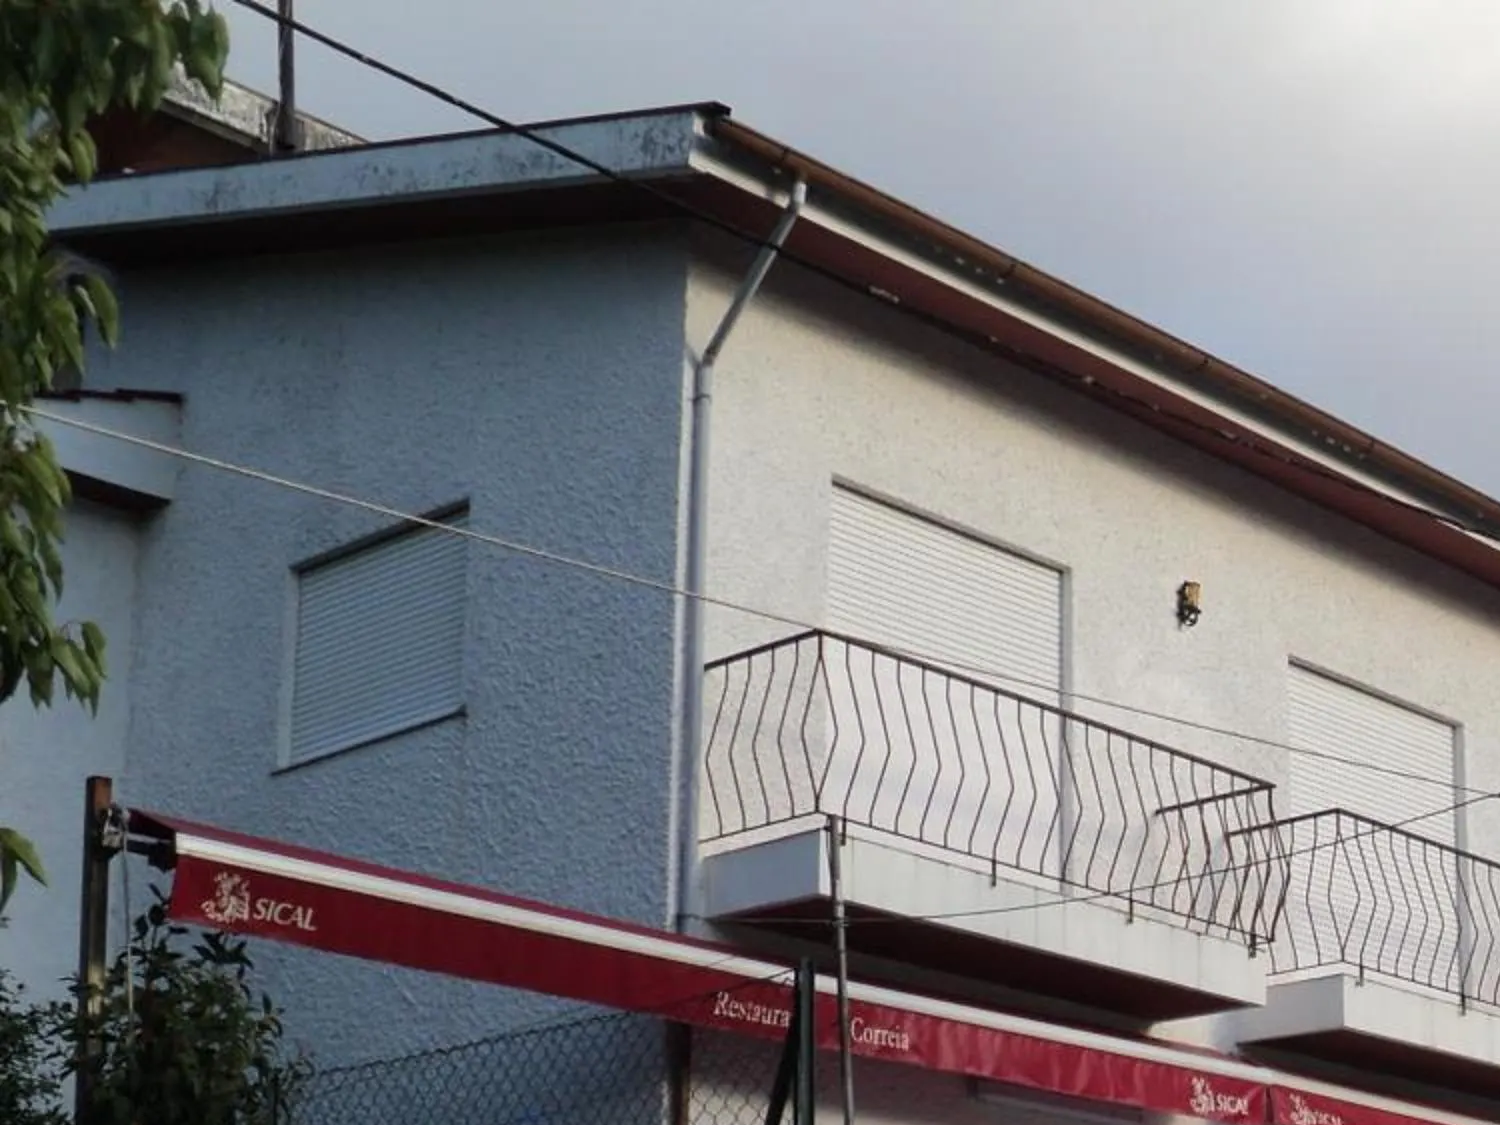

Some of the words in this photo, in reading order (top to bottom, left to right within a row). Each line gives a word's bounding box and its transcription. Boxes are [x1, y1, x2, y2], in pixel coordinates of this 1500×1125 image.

[252, 897, 318, 931] SICAL
[713, 991, 791, 1028] Restaura
[850, 1017, 910, 1051] Correia
[1215, 1092, 1249, 1115] SICAL
